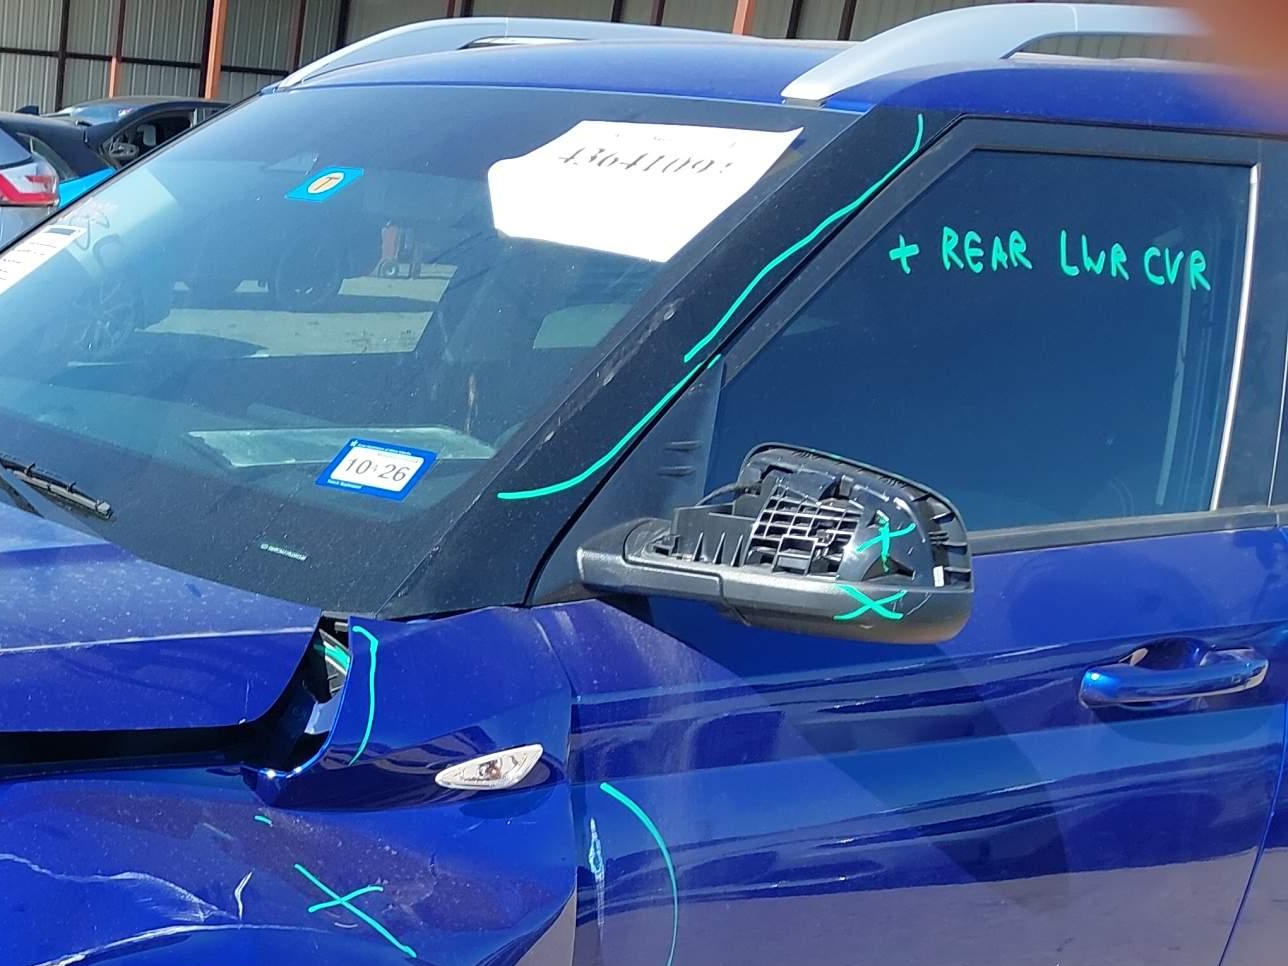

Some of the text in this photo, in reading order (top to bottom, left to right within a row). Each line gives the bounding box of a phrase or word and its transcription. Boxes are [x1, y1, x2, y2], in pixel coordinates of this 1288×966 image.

[941, 226, 1033, 273] REAR
[1060, 229, 1130, 280] LWR
[1143, 246, 1211, 291] CVR
